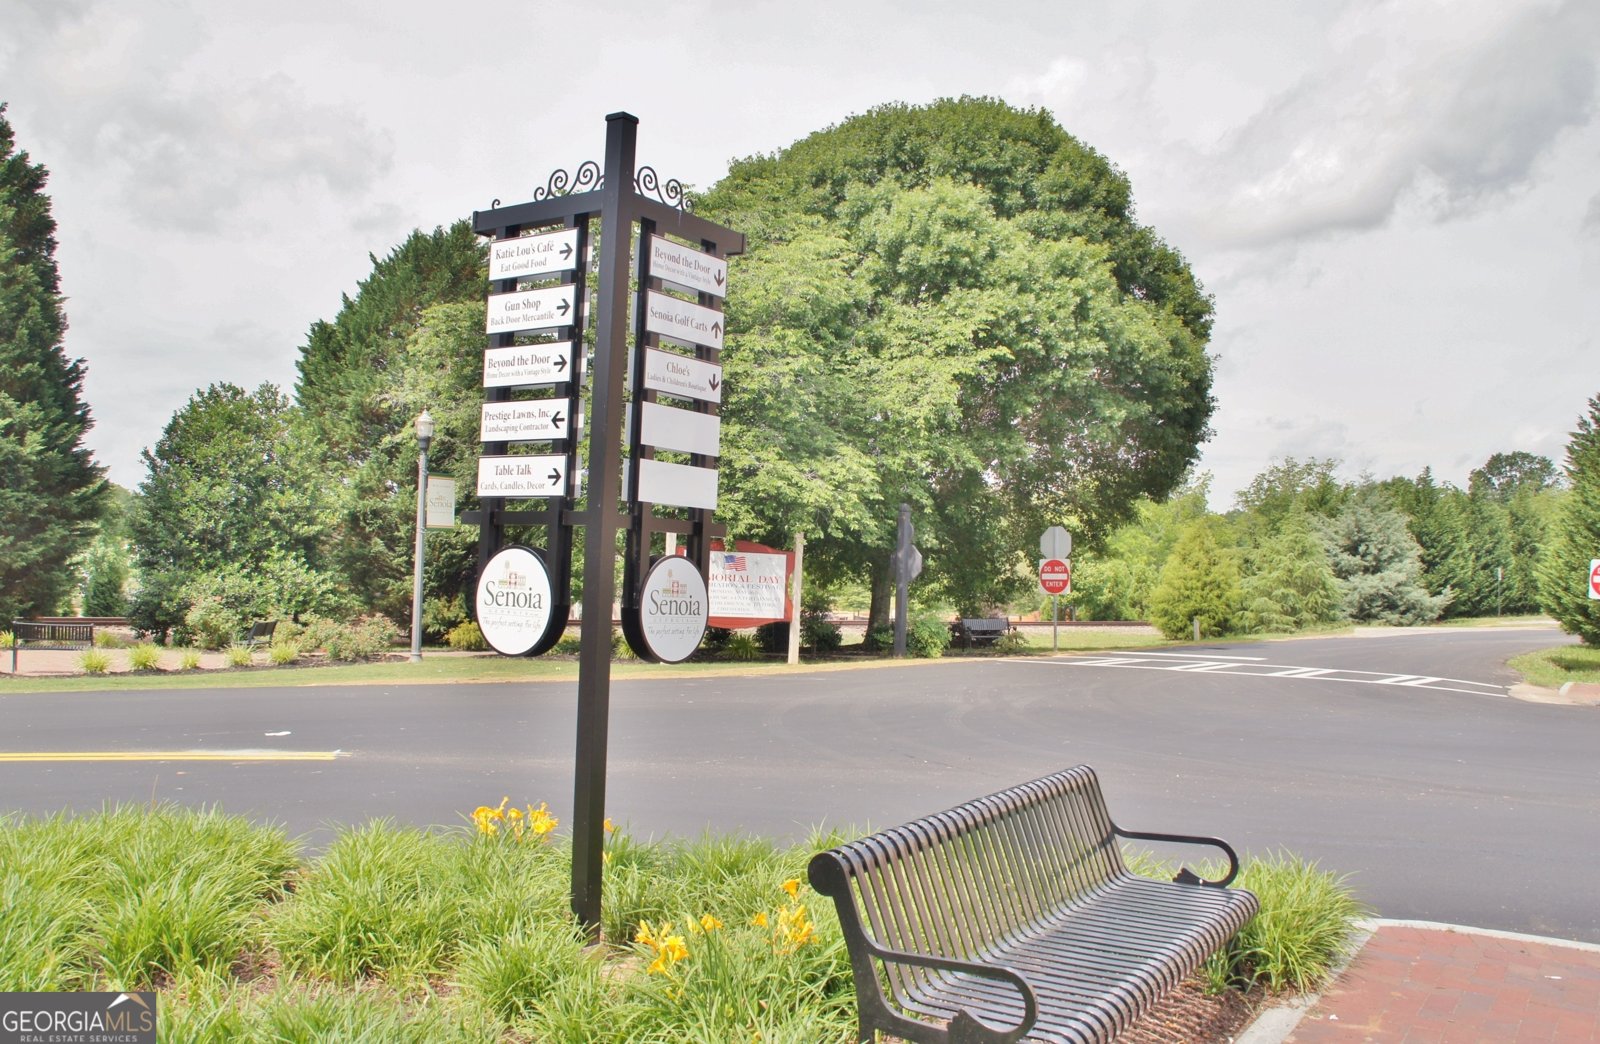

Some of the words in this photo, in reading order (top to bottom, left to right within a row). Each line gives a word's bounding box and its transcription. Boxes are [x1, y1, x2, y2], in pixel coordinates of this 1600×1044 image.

[496, 248, 515, 260] Katie
[517, 244, 535, 256] Lou's
[537, 240, 554, 252] Café
[501, 262, 511, 272] Eat
[512, 259, 529, 270] Good
[531, 258, 546, 268] Food
[655, 247, 680, 264] Beyond
[682, 256, 692, 268] the
[694, 260, 710, 274] Door
[505, 301, 520, 312] Gun
[522, 299, 541, 311] Shop
[490, 317, 504, 326] Back
[506, 315, 520, 324] Door
[522, 311, 554, 322] Mercantile
[650, 307, 673, 322] Senoia
[675, 314, 690, 328] Golf
[691, 319, 707, 332] Carts
[488, 356, 515, 371] Beyond
[517, 355, 528, 366] the
[531, 354, 550, 365] Door
[667, 362, 690, 376] Chloe's
[485, 411, 511, 424] Prestige
[513, 410, 537, 420] Lawns,
[538, 408, 551, 418] Inc.
[485, 424, 518, 433] Landscaping
[519, 423, 549, 431] Contractor
[495, 465, 514, 476] Table
[516, 464, 532, 475] Talk
[480, 482, 498, 491] Cards,
[500, 481, 525, 491] Candles,
[484, 581, 542, 609] Senoia
[649, 590, 701, 616] Senoia
